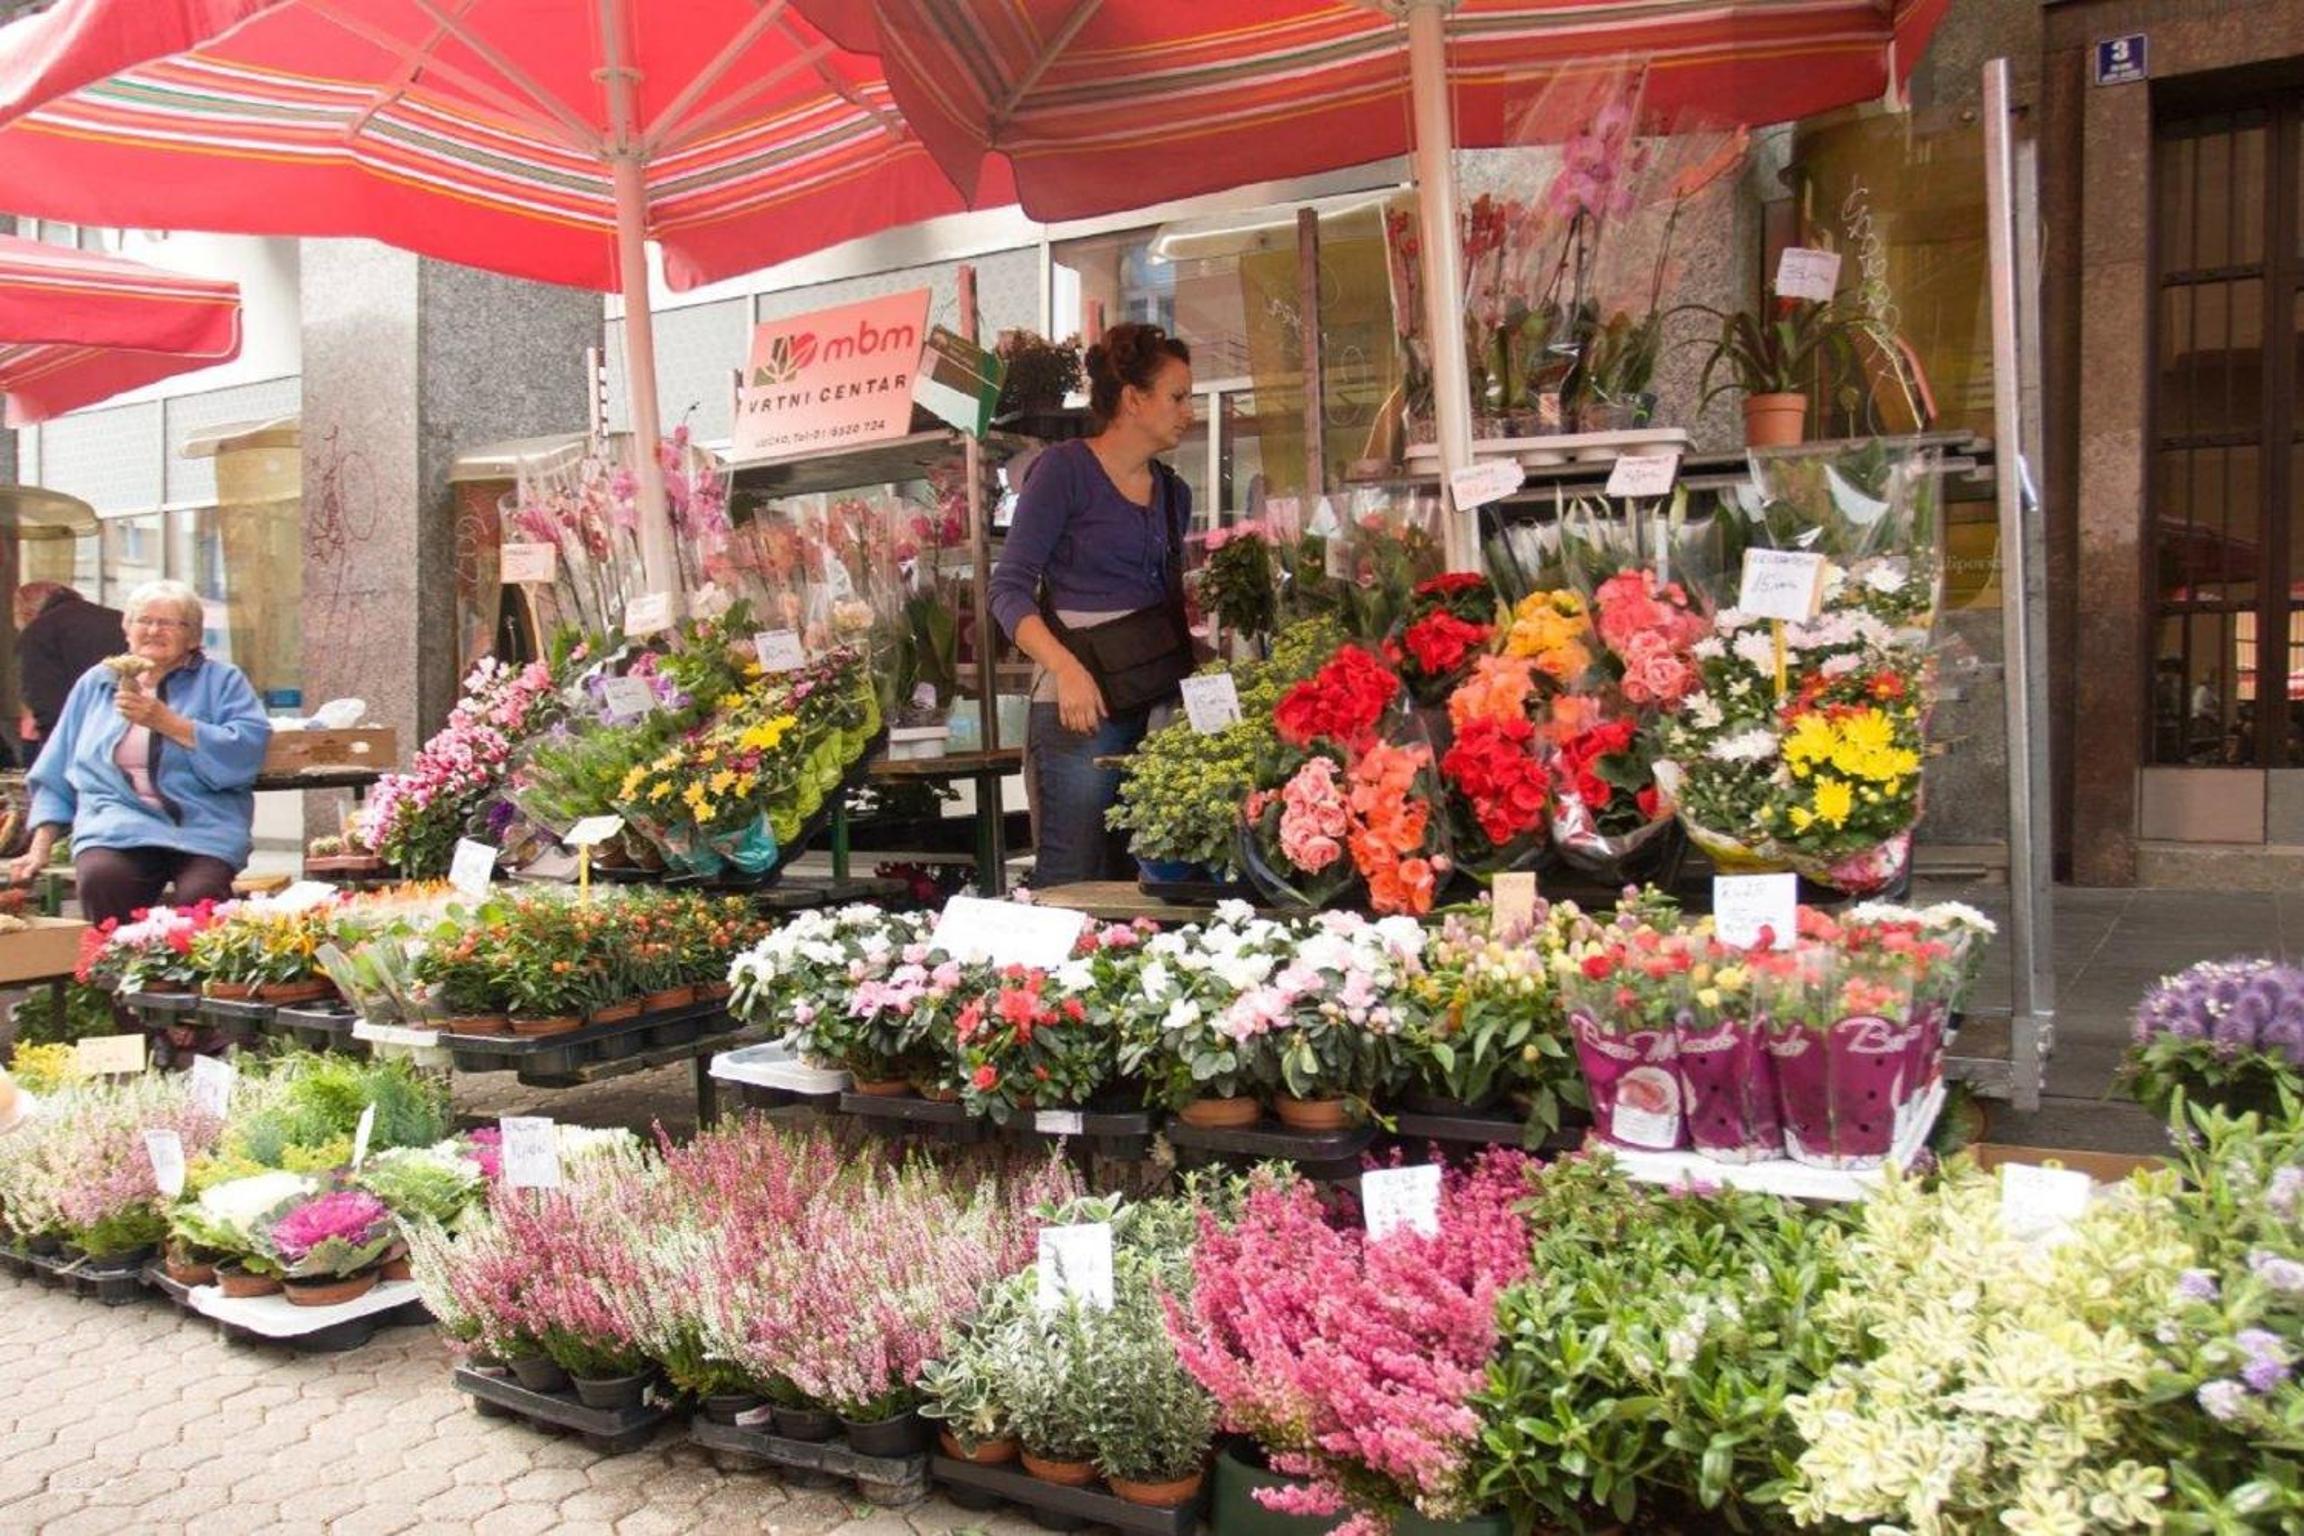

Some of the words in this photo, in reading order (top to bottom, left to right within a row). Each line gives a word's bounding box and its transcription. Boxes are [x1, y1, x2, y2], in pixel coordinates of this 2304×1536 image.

[2111, 40, 2129, 61] 3
[822, 320, 914, 362] mbm
[749, 391, 810, 414] VRTNI
[819, 374, 907, 402] CENTAR
